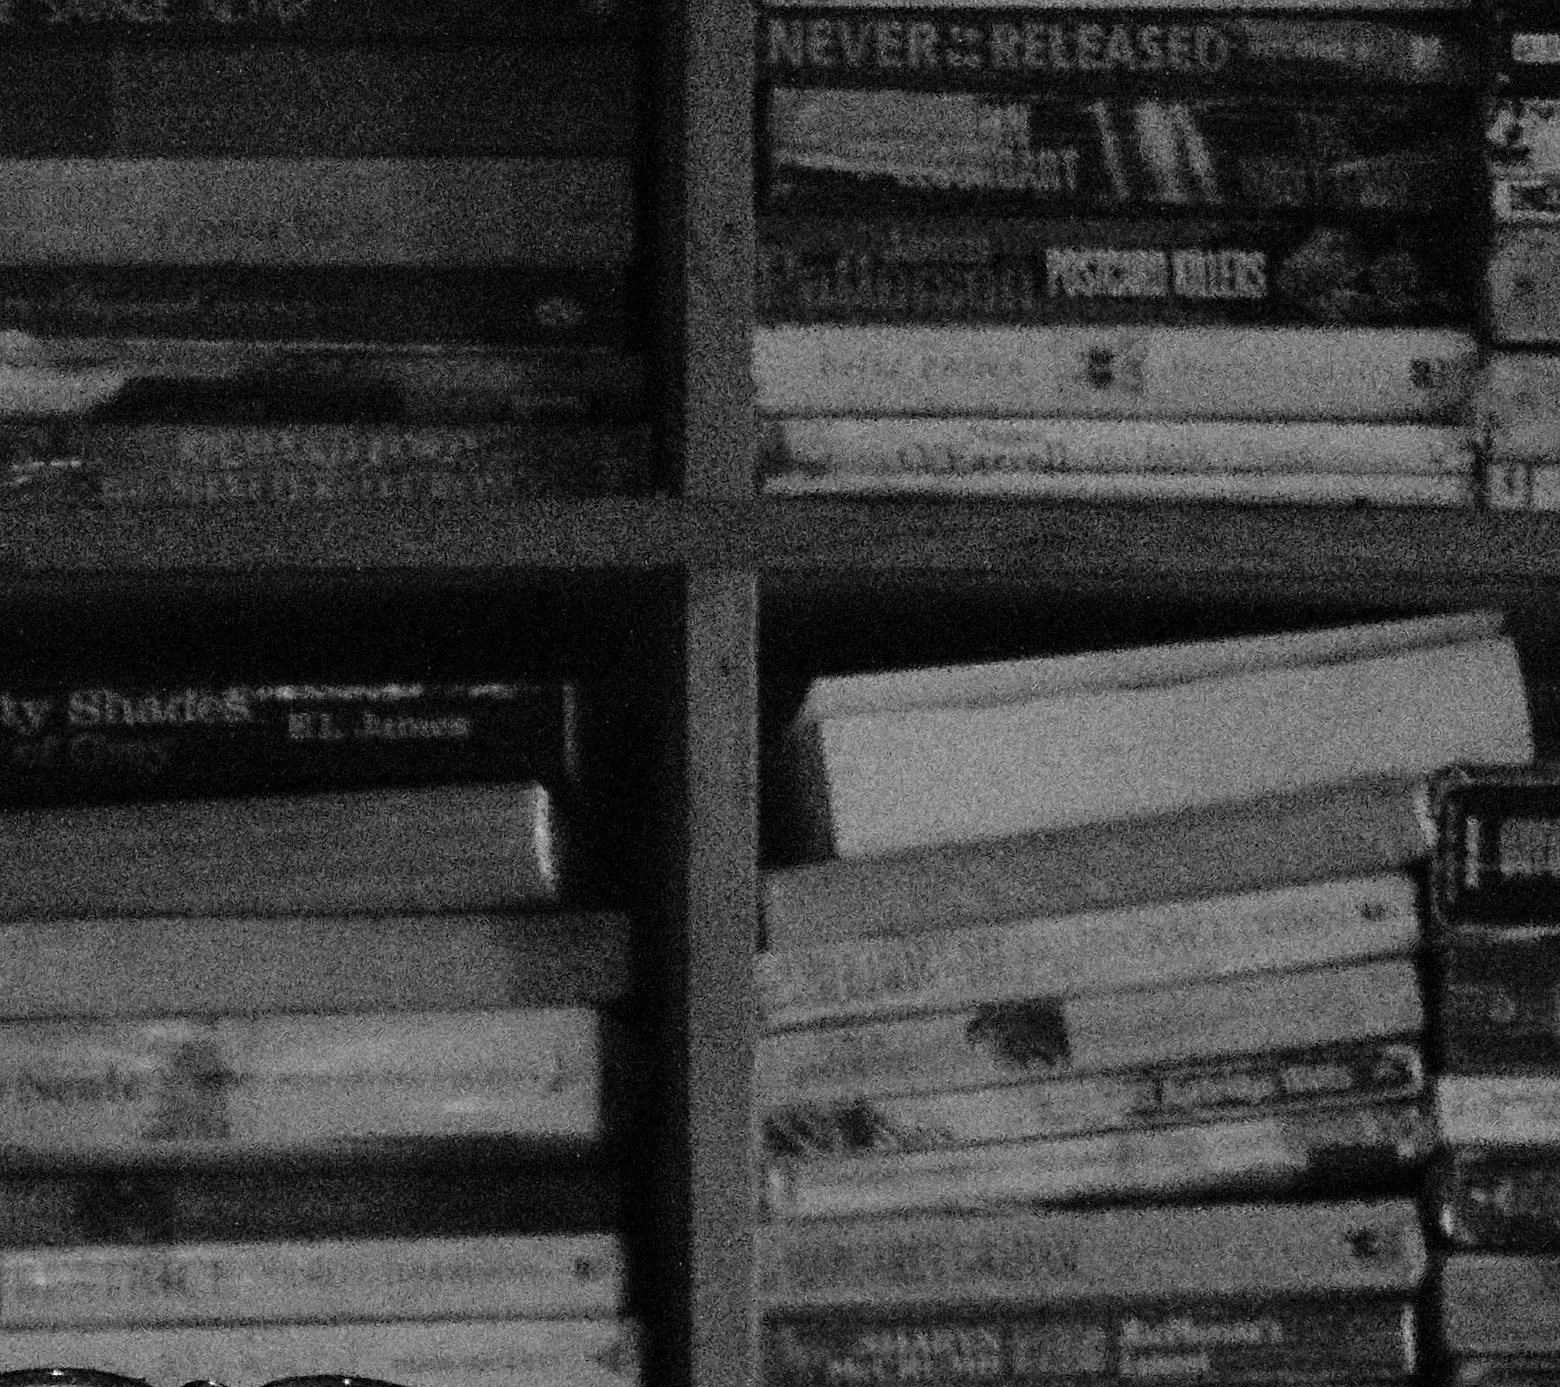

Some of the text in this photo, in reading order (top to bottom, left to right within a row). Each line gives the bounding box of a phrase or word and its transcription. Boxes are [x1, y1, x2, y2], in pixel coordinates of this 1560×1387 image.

[768, 18, 935, 70] NEVER
[988, 21, 1231, 73] RELEASED
[68, 690, 253, 729] Shades
